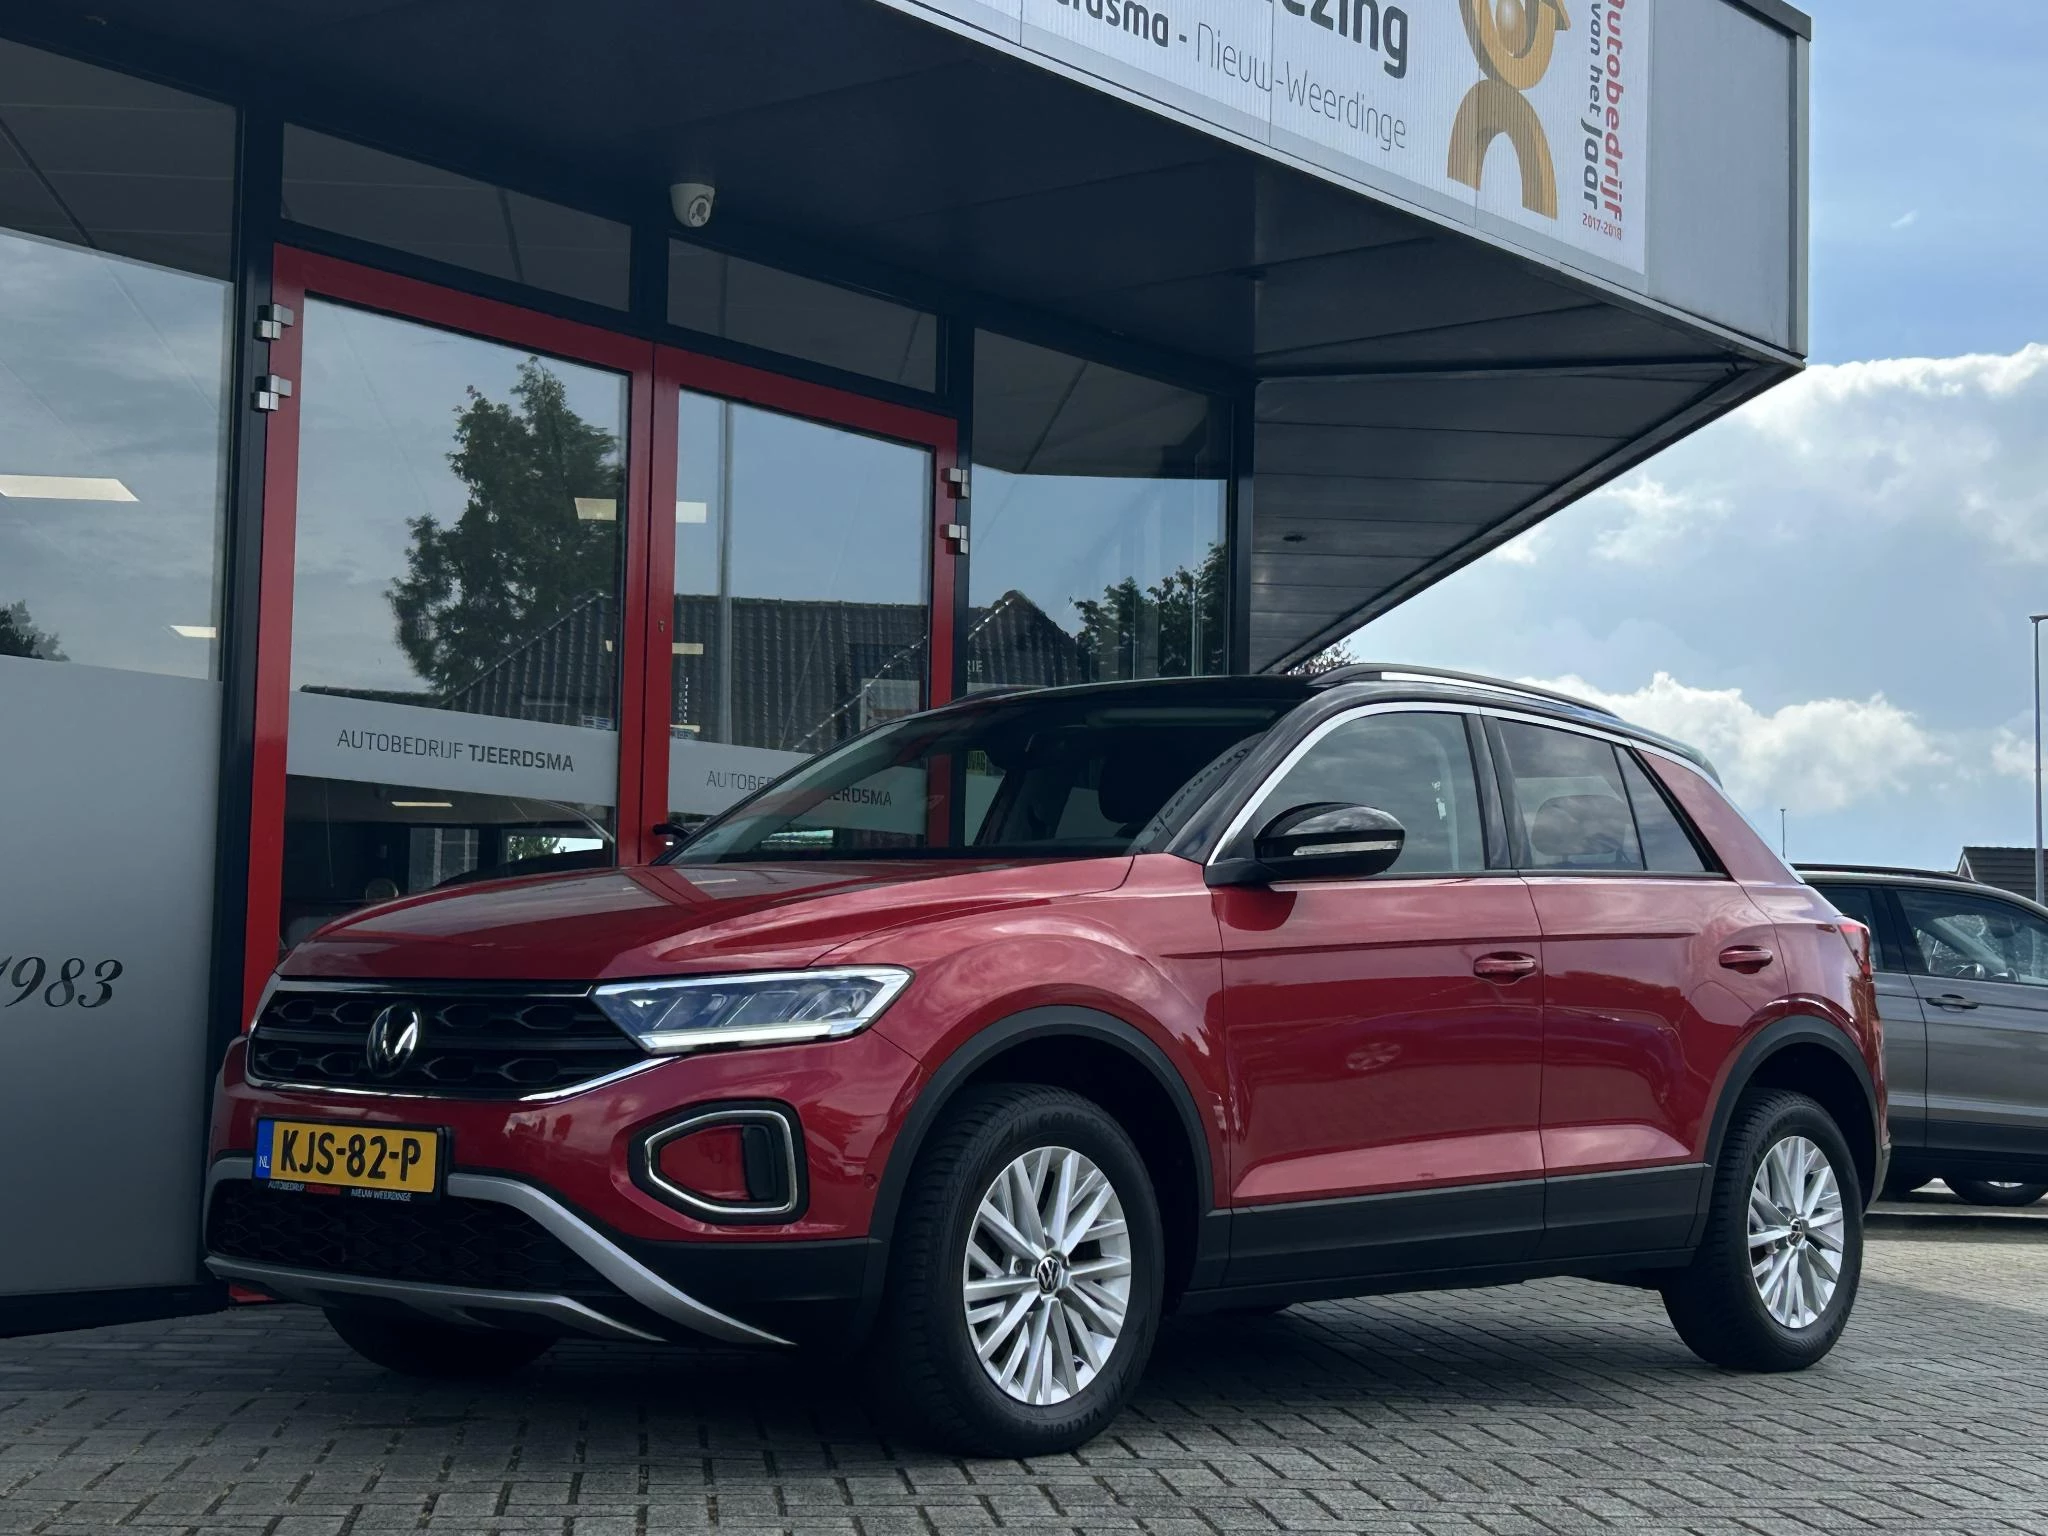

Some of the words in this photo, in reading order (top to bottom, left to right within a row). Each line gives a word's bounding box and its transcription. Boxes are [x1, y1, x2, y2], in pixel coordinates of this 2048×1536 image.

[1057, 0, 1168, 47] sma
[1590, 3, 1602, 56] van
[1590, 64, 1604, 117] het
[1601, 0, 1624, 222] autobedrijf
[1582, 212, 1622, 241] 2017-2018
[337, 729, 463, 759] AUTOBEDRIJF
[468, 744, 574, 772] TJEERDSMA
[259, 1156, 269, 1168] NL
[280, 1129, 421, 1182] KJS-82-P
